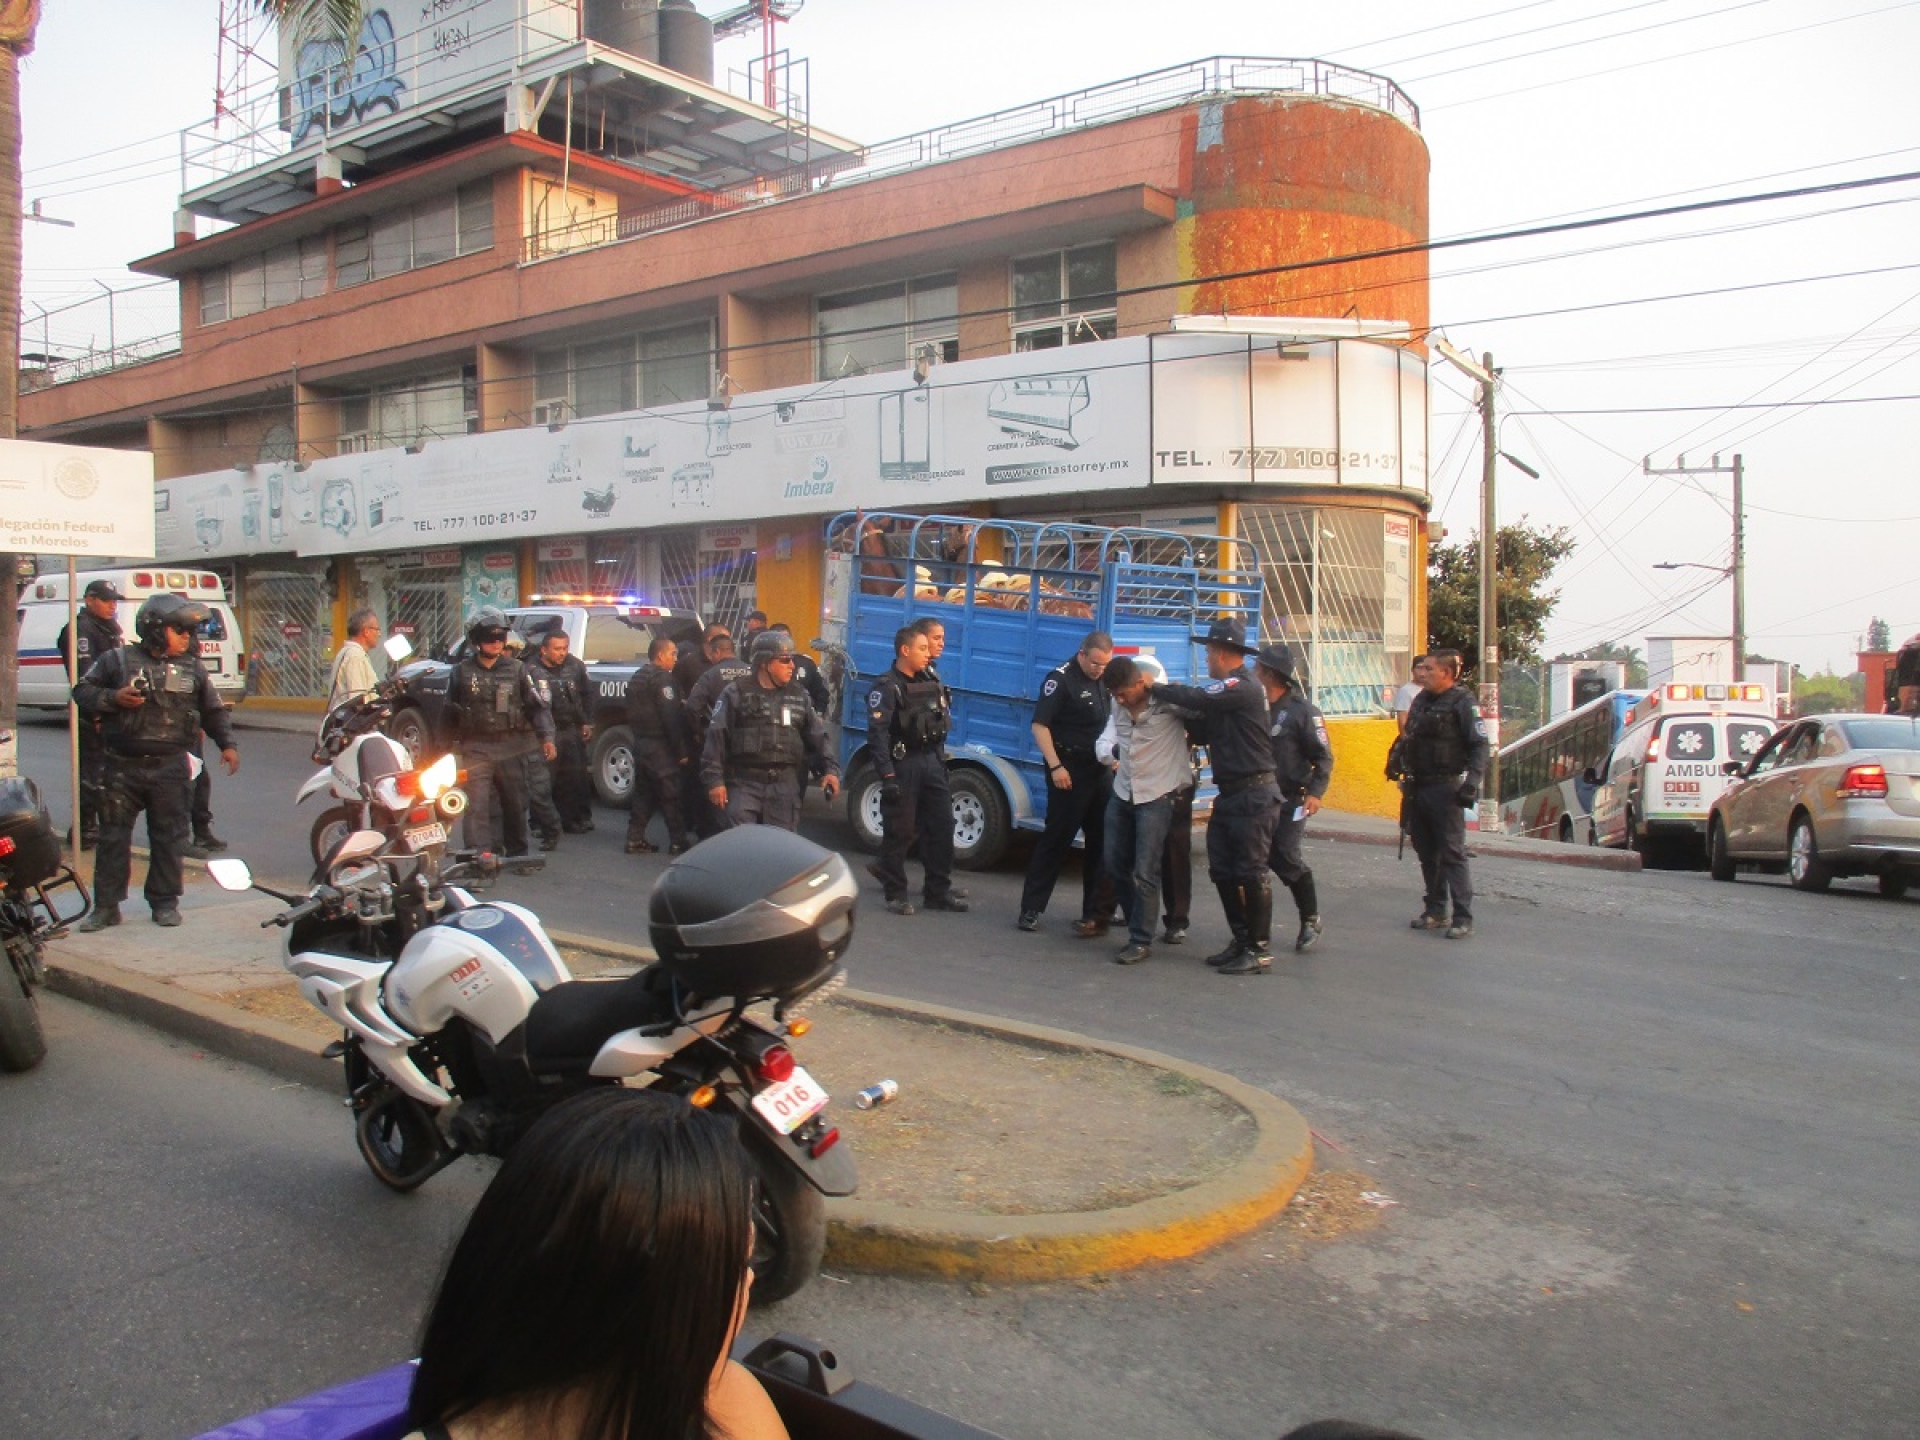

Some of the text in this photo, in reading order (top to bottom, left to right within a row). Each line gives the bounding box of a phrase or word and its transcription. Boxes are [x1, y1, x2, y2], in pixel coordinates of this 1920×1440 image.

[1156, 450, 1212, 468] TEL.
[992, 459, 1129, 481] www.ventastorrey.mx
[784, 479, 835, 498] Imbera
[64, 521, 115, 534] Federal
[413, 520, 436, 532] TEL.
[10, 535, 89, 548] en Morelos
[1665, 783, 1698, 792] 911
[452, 959, 479, 982] 911
[773, 1085, 810, 1116] 016
